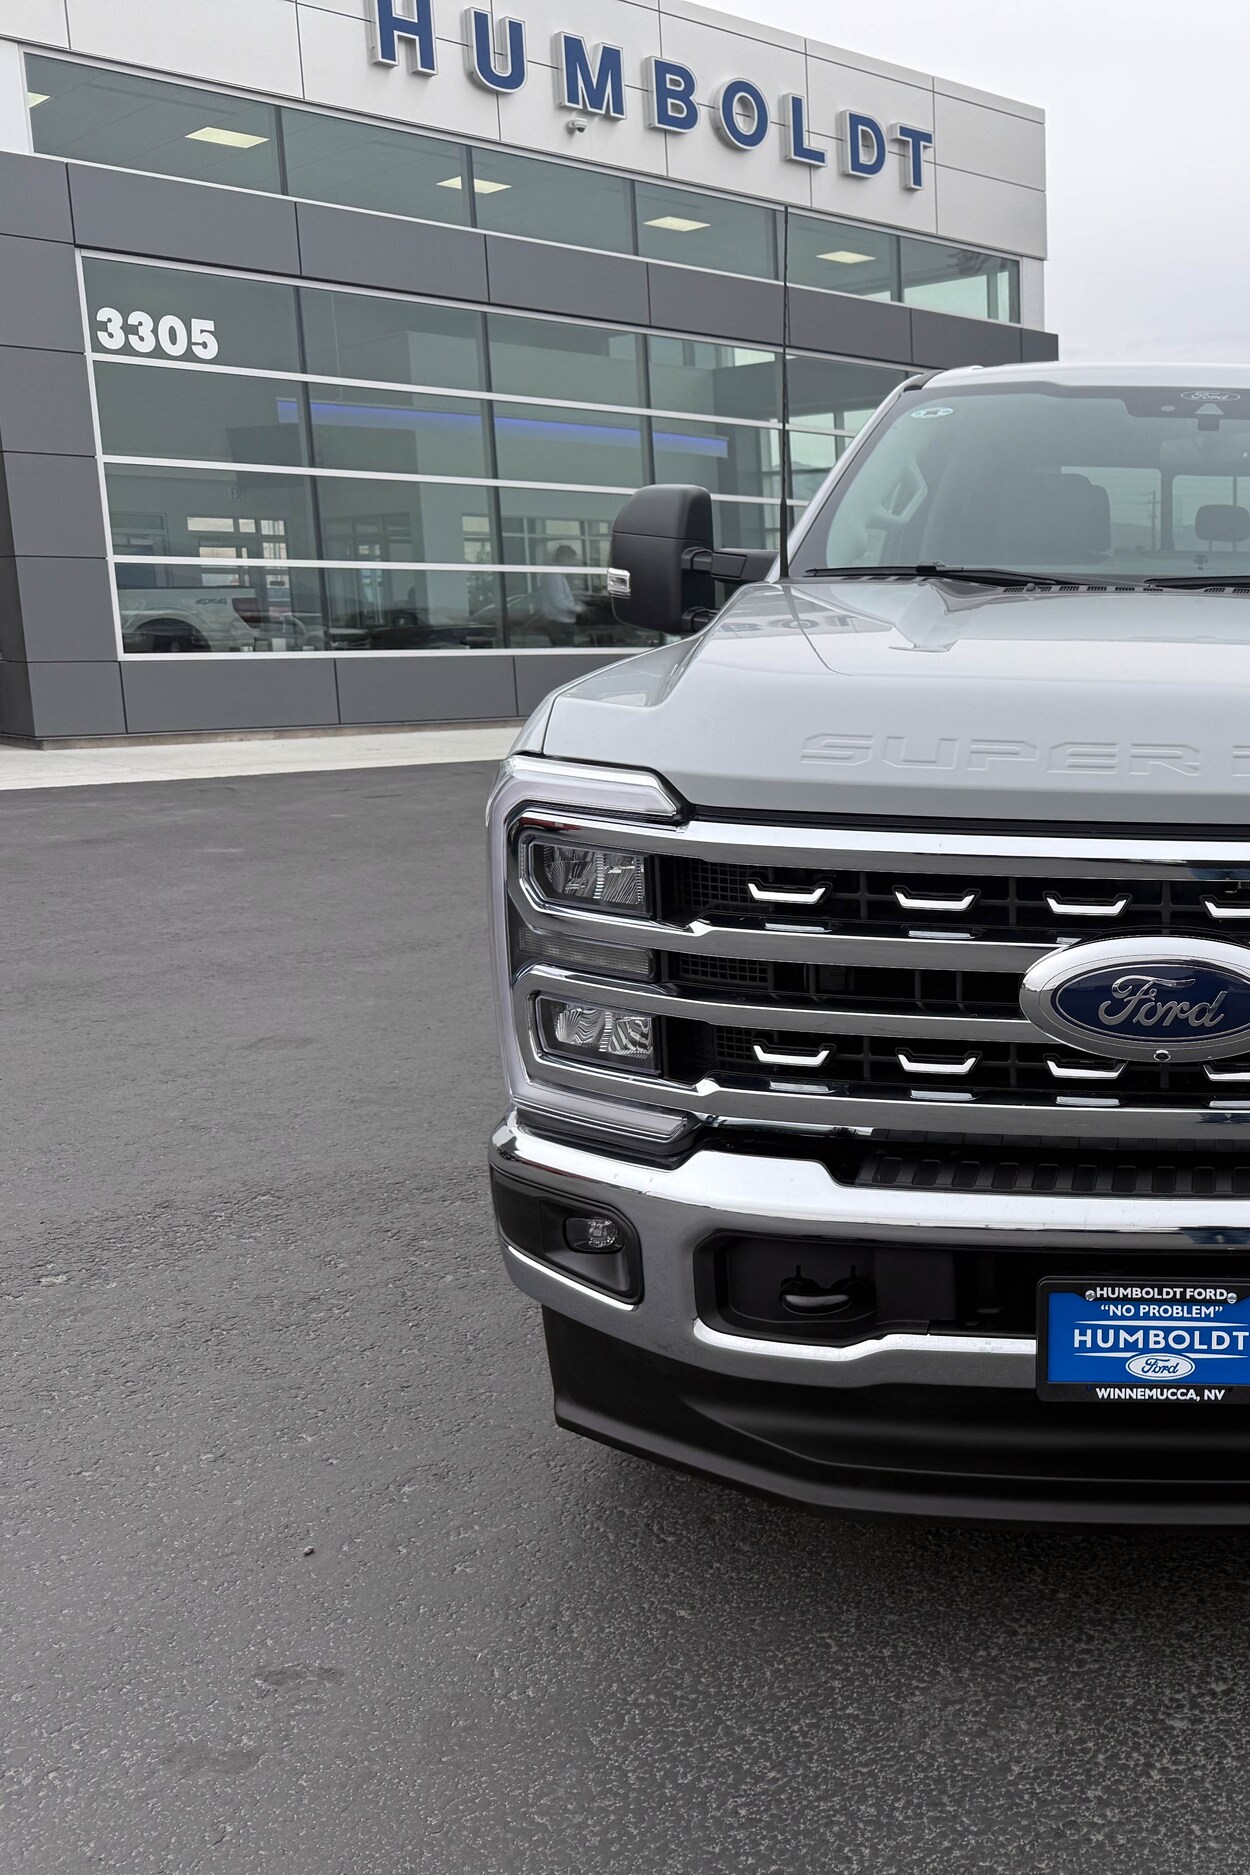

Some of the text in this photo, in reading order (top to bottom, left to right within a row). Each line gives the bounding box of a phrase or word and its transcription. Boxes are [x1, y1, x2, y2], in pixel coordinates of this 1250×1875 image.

[372, 0, 935, 191] HUMBOLDT
[95, 306, 219, 360] 3305
[801, 732, 1201, 777] SUPER
[1097, 974, 1228, 1028] Ford
[1096, 1287, 1228, 1300] HUMBOLDT FORD
[1073, 1329, 1250, 1351] HUMBOLDT
[1141, 1358, 1179, 1374] Ford
[1096, 1388, 1226, 1402] WINNEMUCCA, NV
